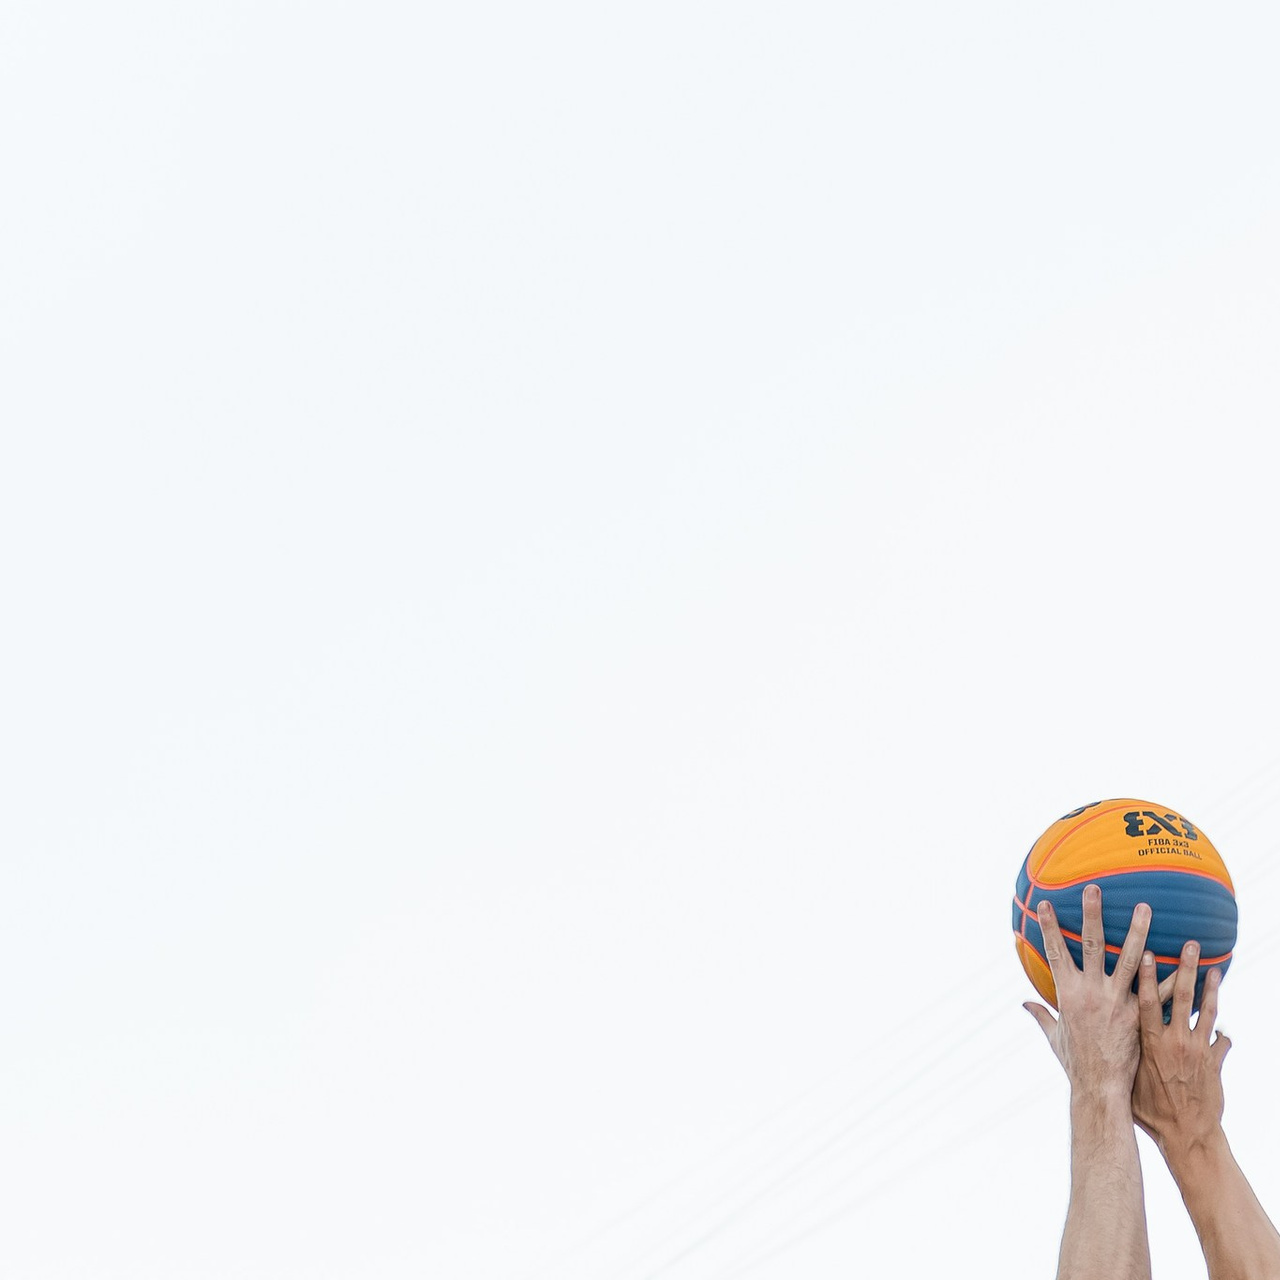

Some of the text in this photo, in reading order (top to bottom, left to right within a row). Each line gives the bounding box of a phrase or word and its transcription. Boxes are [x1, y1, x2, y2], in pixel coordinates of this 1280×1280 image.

[1148, 838, 1171, 847] FIBA
[1138, 847, 1203, 861] OFFICIAL BALL
